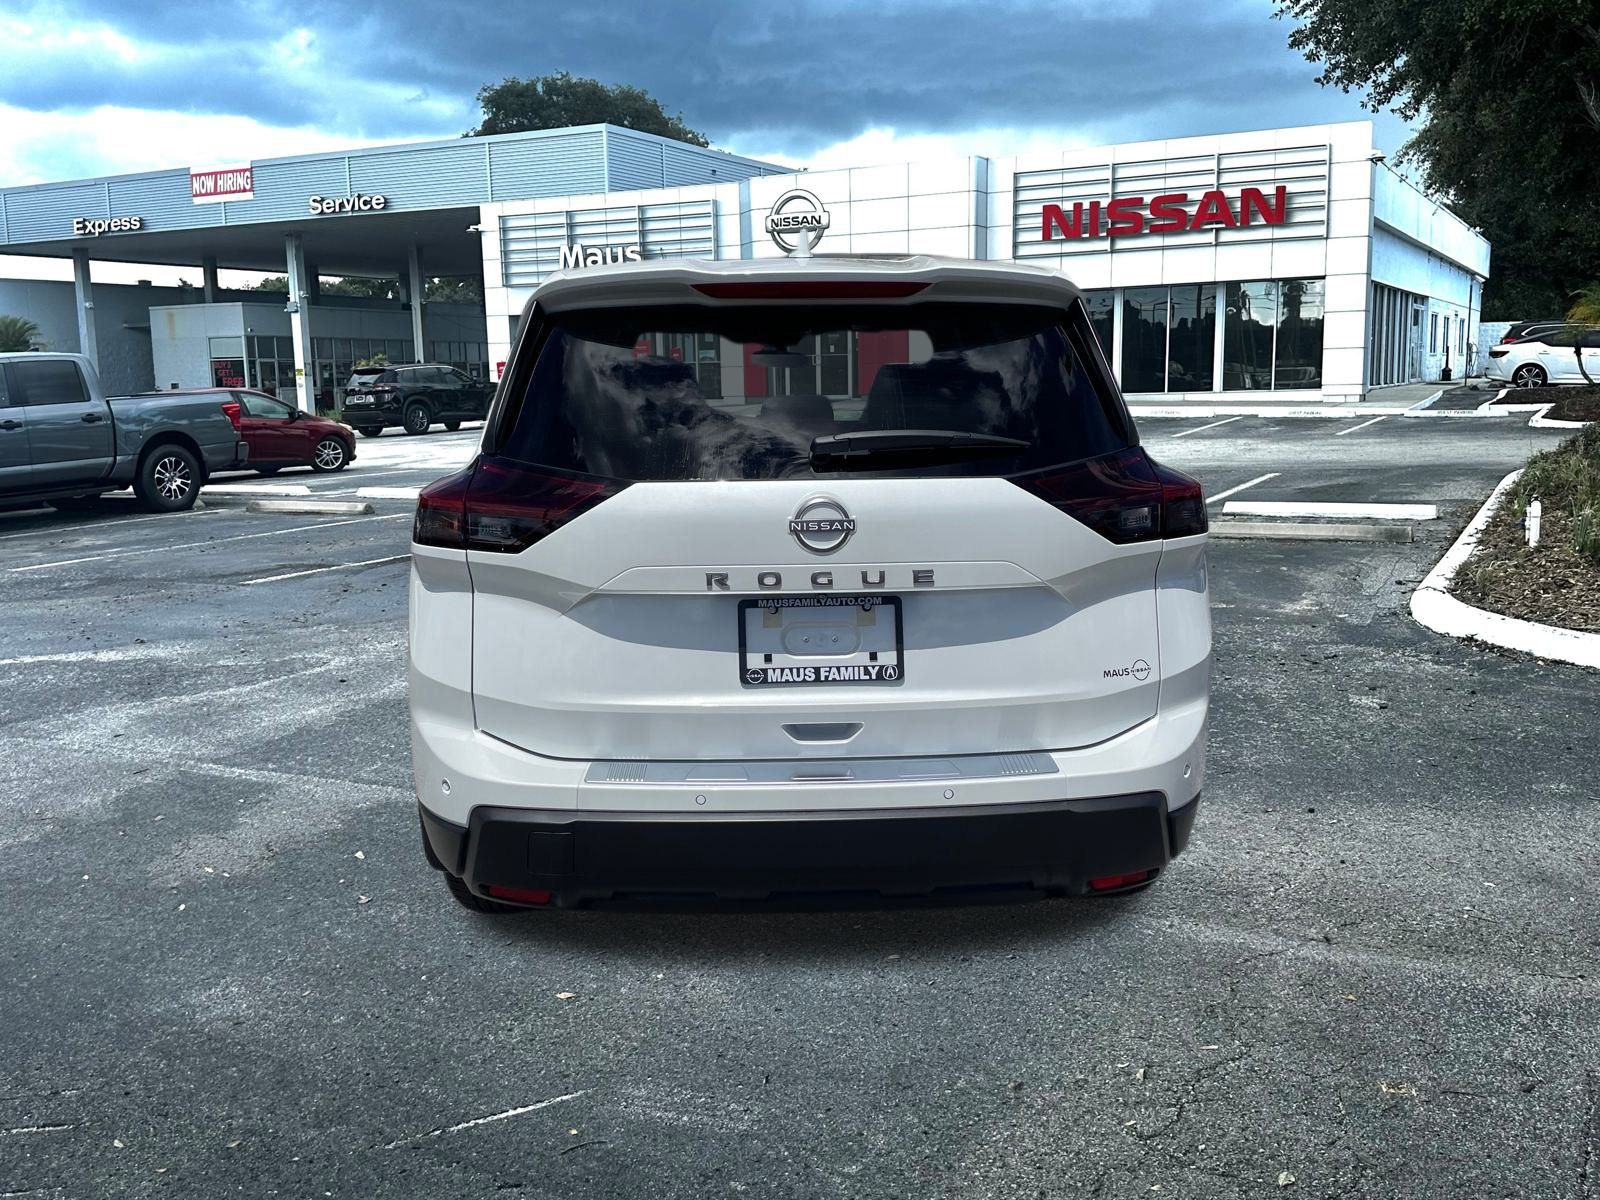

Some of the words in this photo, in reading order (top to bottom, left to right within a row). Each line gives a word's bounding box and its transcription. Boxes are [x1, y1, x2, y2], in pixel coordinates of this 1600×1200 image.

[192, 173, 216, 195] NOW
[216, 171, 251, 191] HIRING
[308, 193, 386, 215] Service
[1041, 185, 1287, 241] NISSAN
[73, 216, 141, 237] Express
[770, 214, 822, 230] NISSAN
[558, 243, 642, 270] Maus
[223, 377, 244, 387] FREE
[790, 520, 855, 531] NISSAN
[705, 569, 935, 589] ROGUE
[758, 597, 883, 608] MAUSFAMILYAUTO.COM
[767, 667, 816, 683] MAUS
[820, 666, 880, 681] FAMILY
[1103, 667, 1130, 679] MAUS
